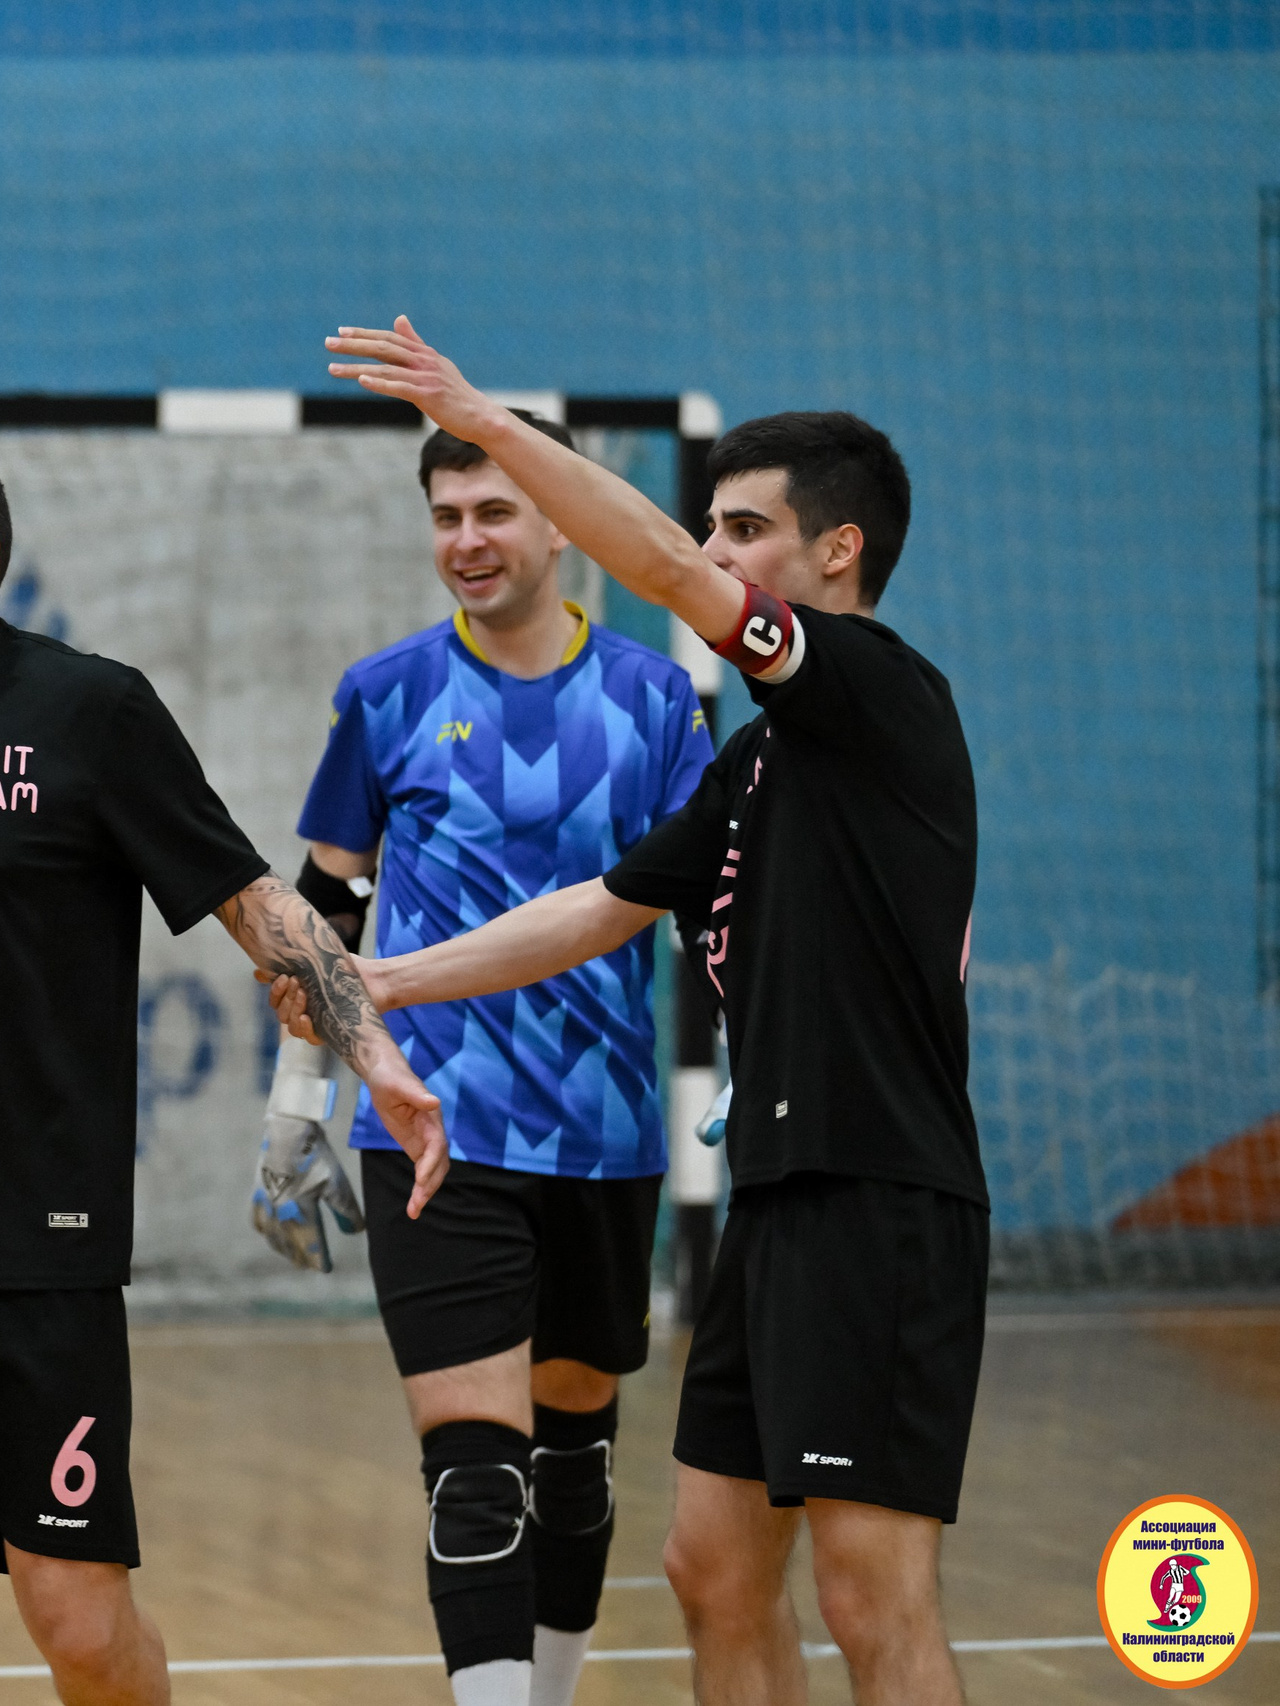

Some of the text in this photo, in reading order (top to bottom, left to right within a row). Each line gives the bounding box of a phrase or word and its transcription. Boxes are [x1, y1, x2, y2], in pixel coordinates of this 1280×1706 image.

[742, 616, 782, 657] C
[50, 1415, 97, 1508] 6
[801, 1452, 821, 1464] 2K
[37, 1513, 90, 1528] 2K SPORT
